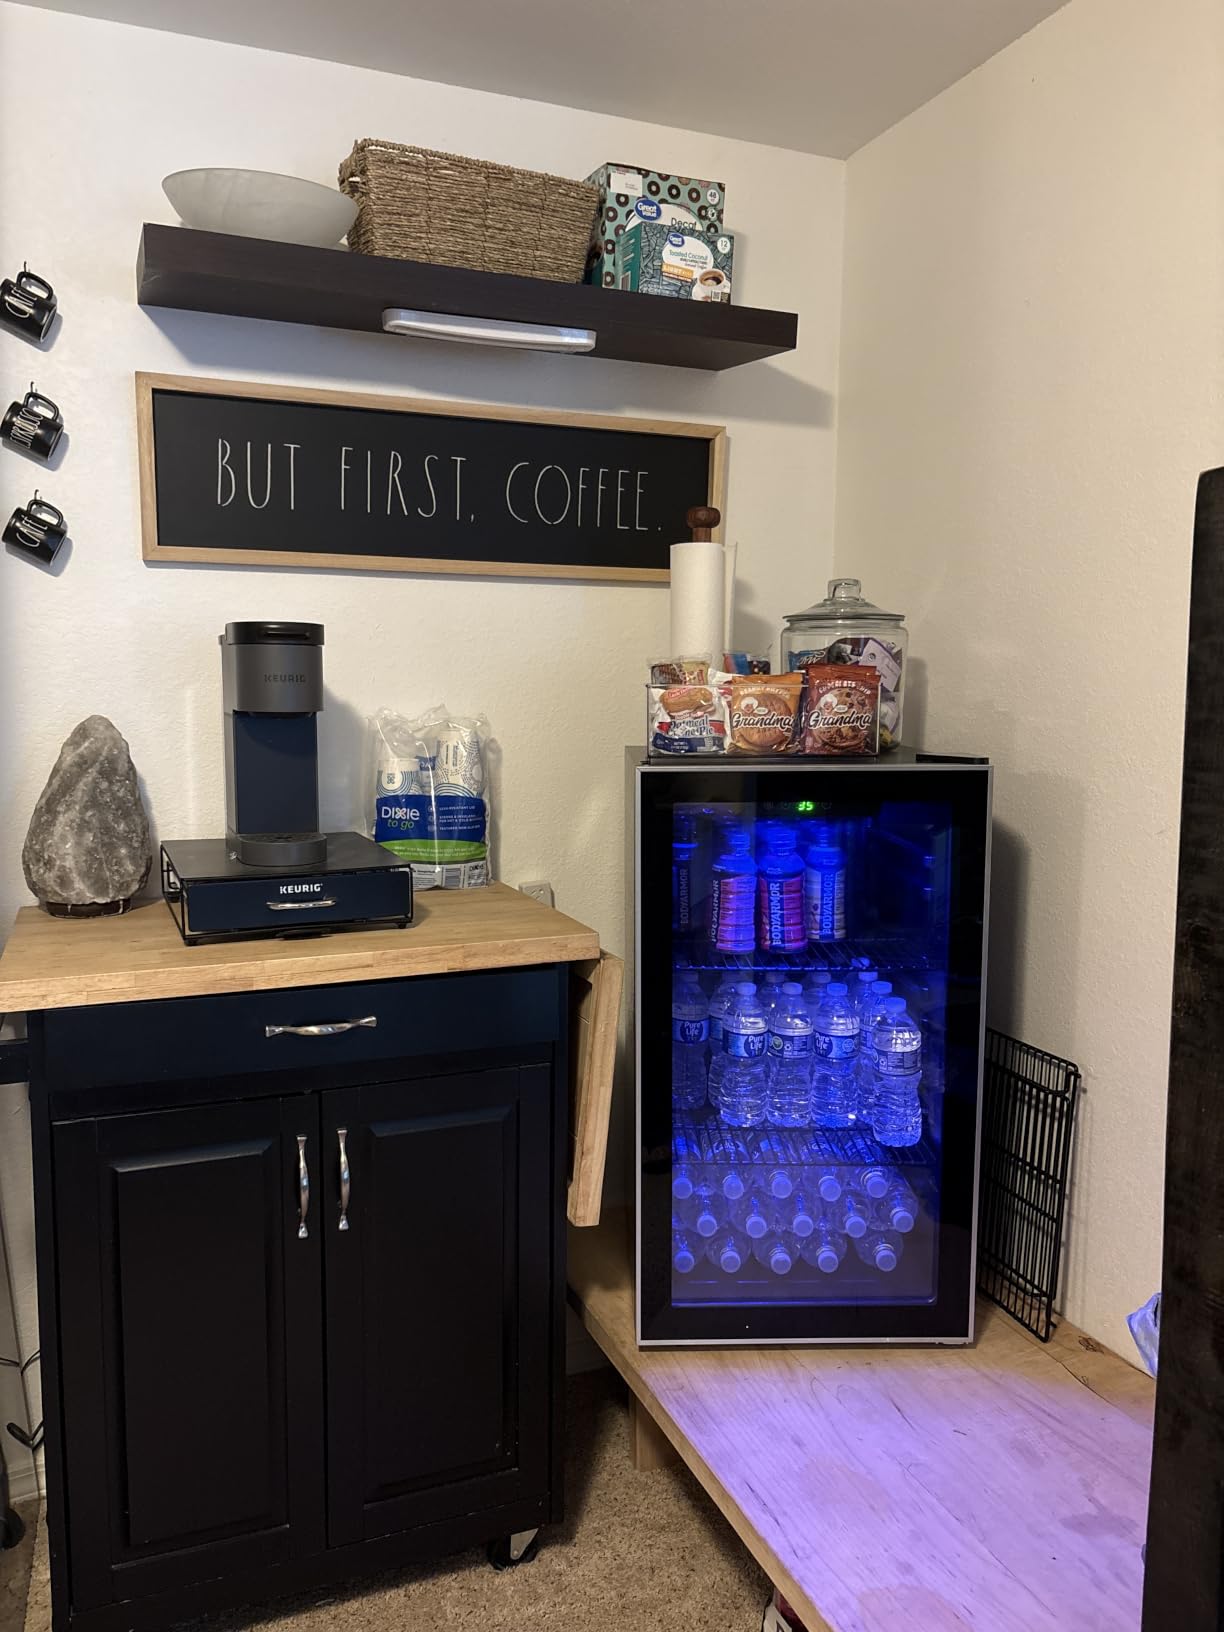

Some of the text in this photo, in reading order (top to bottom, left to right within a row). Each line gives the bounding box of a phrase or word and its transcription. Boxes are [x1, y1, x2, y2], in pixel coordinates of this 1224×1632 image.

[720, 239, 729, 247] 12
[216, 439, 663, 532] BUT FIRST, COFFEE.
[264, 673, 306, 683] KEURIG
[798, 800, 814, 811] 35
[387, 819, 415, 831] to go
[279, 883, 321, 895] KEURIG
[679, 868, 689, 924] BODYARMOR
[821, 873, 835, 936] BODYARMOR
[769, 882, 782, 946] BODYARMOR
